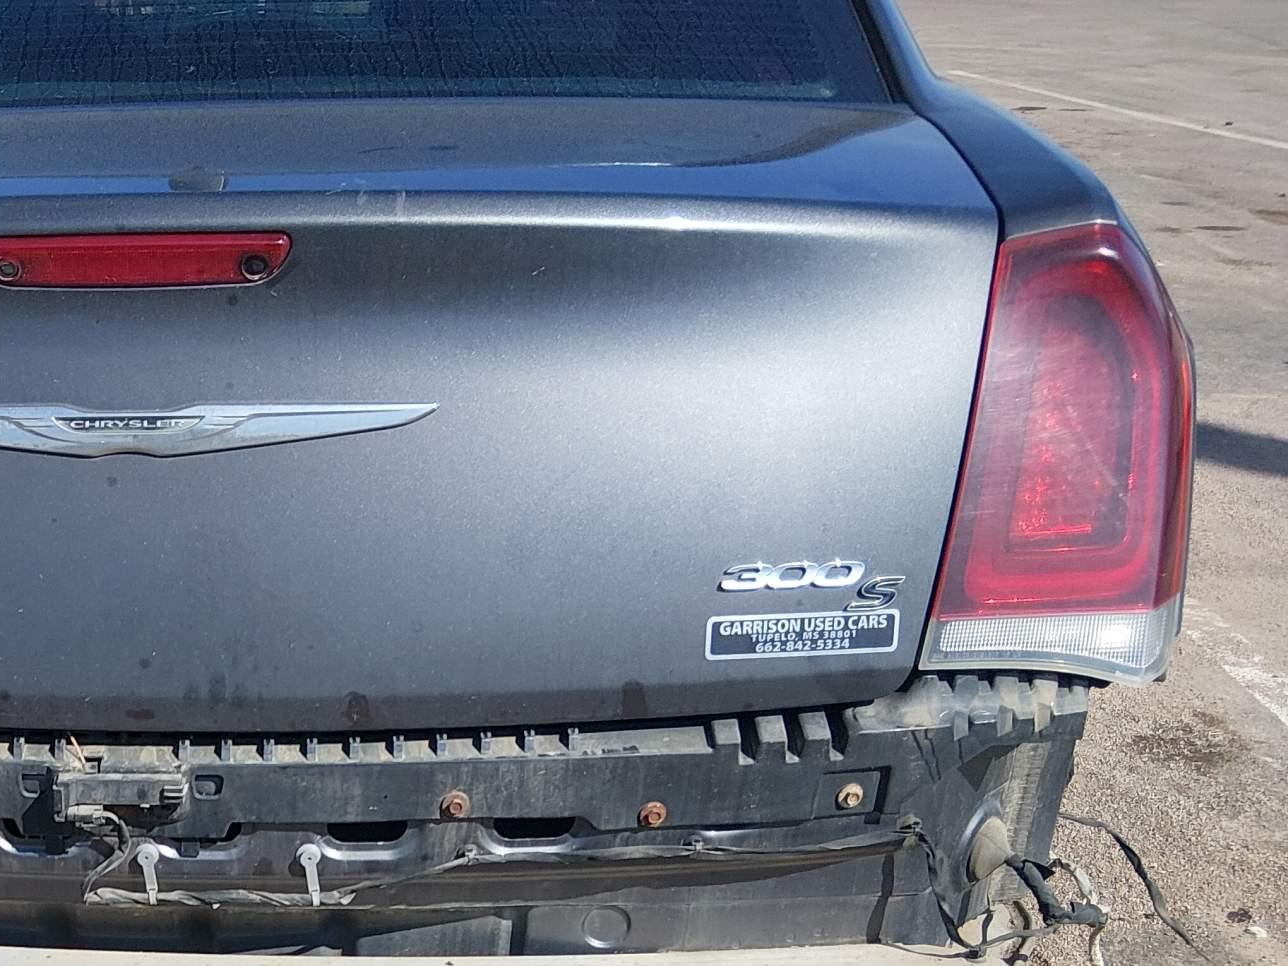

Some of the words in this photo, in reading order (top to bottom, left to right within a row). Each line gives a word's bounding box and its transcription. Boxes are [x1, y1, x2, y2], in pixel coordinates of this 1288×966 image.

[70, 419, 185, 429] CHRYSLER
[718, 558, 865, 591] 300
[719, 618, 801, 635] GARRISON
[804, 617, 845, 632] USED
[848, 614, 888, 629] CARS
[751, 633, 799, 642] TUPELO,
[802, 632, 819, 640] MS
[823, 630, 857, 639] 38801
[755, 638, 850, 653] 662-842-5334
